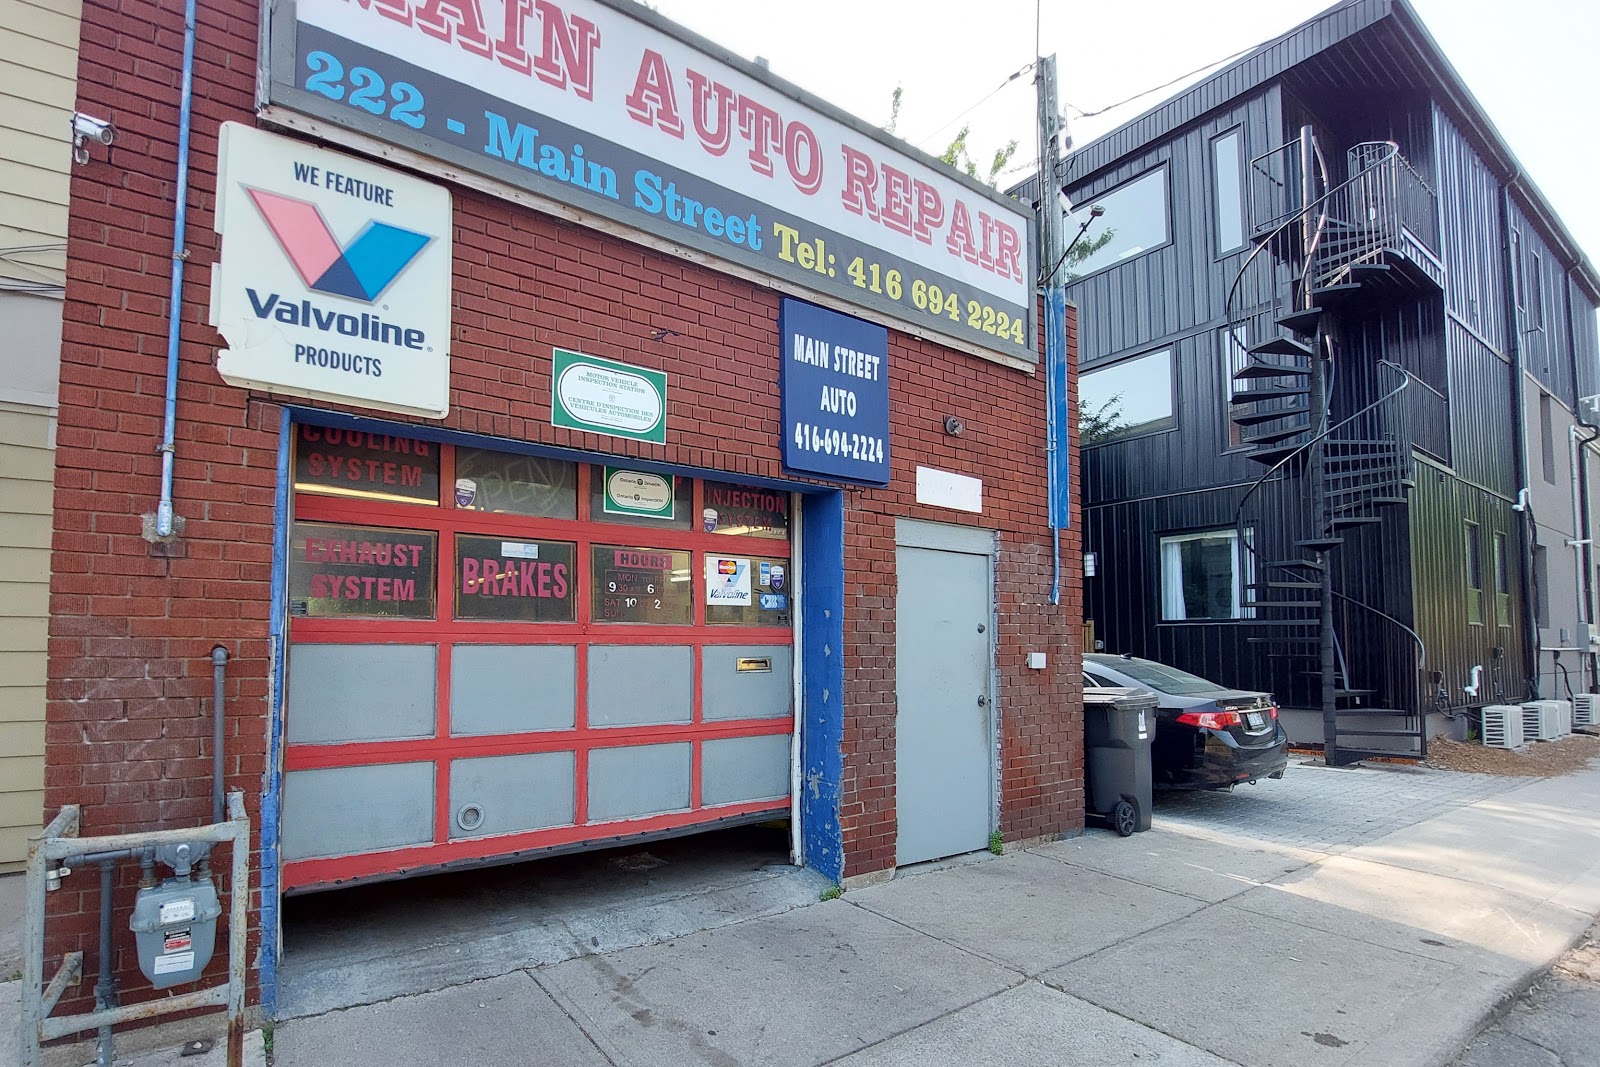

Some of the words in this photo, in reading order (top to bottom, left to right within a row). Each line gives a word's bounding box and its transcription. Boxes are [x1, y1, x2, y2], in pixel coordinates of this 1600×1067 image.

[626, 48, 824, 196] AUTO
[841, 143, 1024, 285] REPAIR
[293, 161, 320, 187] WE
[325, 170, 394, 207] FEATURE
[305, 50, 425, 129] 222
[484, 111, 620, 199] Main
[634, 169, 763, 251] Street
[773, 222, 837, 278] Tel:
[847, 256, 903, 300] 416
[911, 279, 960, 322] 694
[967, 300, 1025, 345] 2224
[245, 287, 425, 351] Valvoline
[294, 343, 382, 377] PRODUCTS
[793, 333, 829, 369] MAIN
[833, 345, 880, 381] STREET
[578, 375, 618, 389] INSPECTION
[618, 384, 646, 394] STATION
[586, 371, 610, 382] MOTOR
[610, 376, 639, 388] VEHICLE
[568, 396, 596, 407] CENTRE
[641, 410, 654, 418] DES
[608, 410, 653, 423] AUTOMOBILES
[820, 385, 857, 418] AUTO
[794, 422, 884, 464] 416-694-2224
[307, 452, 422, 487] SYSTEM
[707, 488, 786, 513] INJECTION
[719, 512, 773, 531] SYSTEM
[305, 537, 424, 568] EXHAUST
[620, 553, 667, 568] HOURS
[310, 573, 416, 602] SYSTEM
[462, 557, 568, 600] BRAKES
[608, 581, 617, 593] 9
[647, 584, 655, 594] 6
[625, 597, 637, 608] 10
[654, 598, 661, 609] 2
[709, 588, 749, 600] Valvoline
